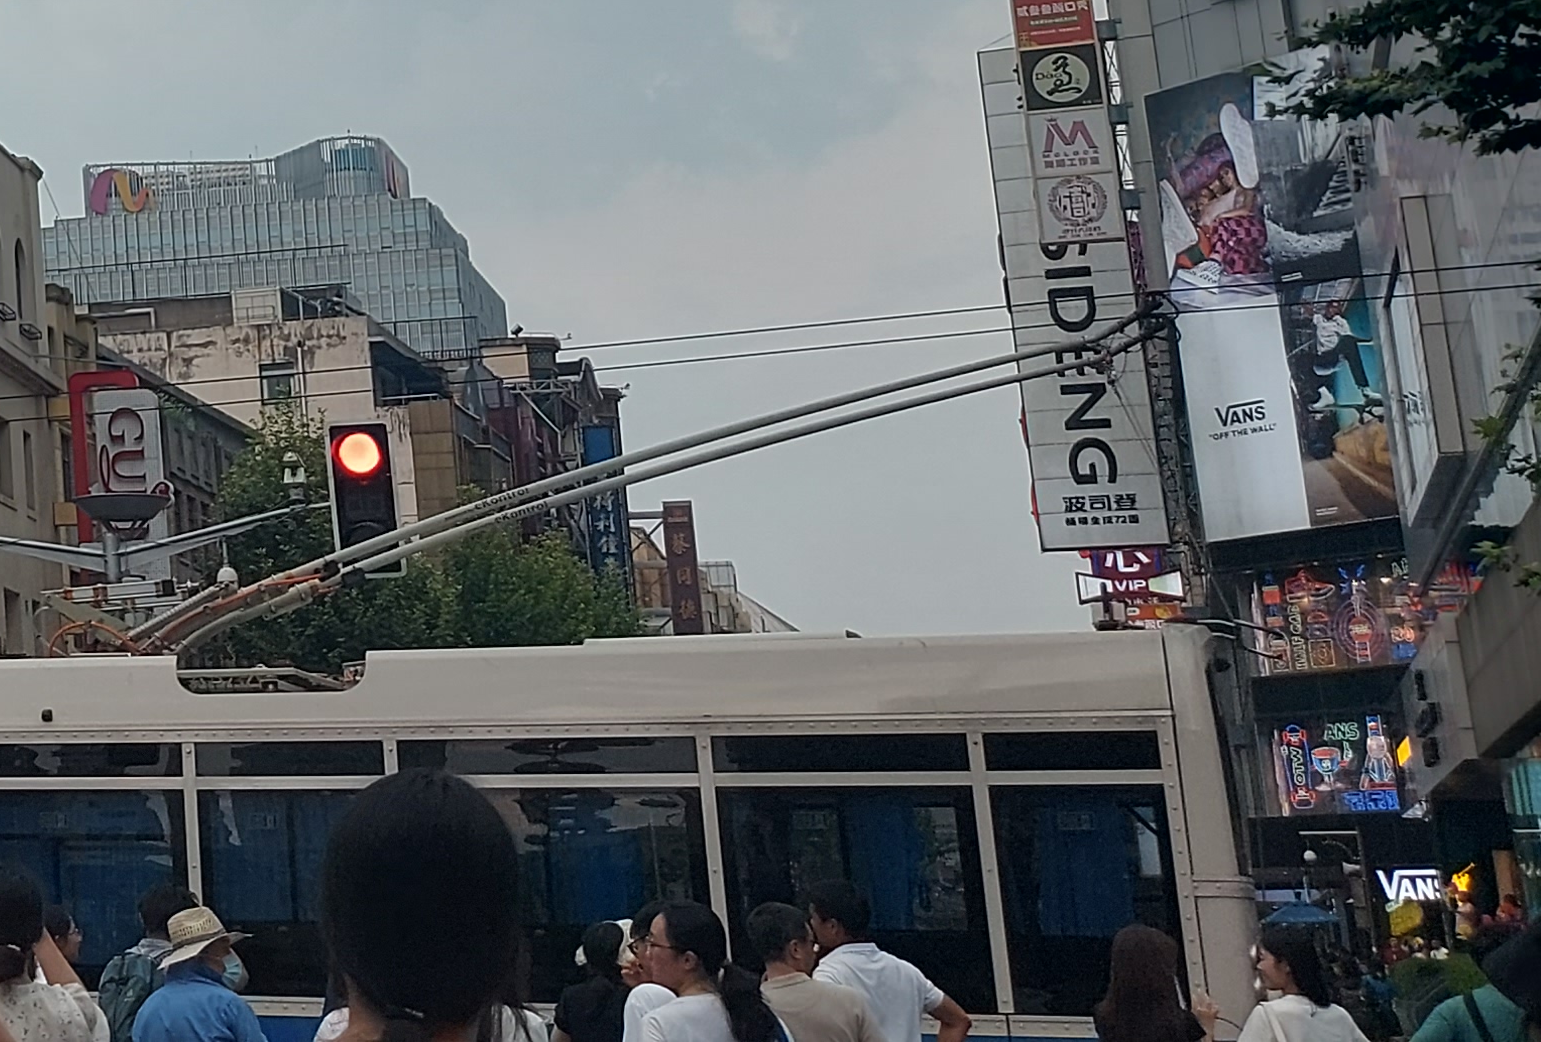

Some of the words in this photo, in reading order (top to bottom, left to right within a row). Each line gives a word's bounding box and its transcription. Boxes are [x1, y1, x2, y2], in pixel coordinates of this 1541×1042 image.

[1215, 400, 1266, 427] VANS
[1062, 493, 1138, 512] 波司登
[1114, 579, 1147, 592] VIP
